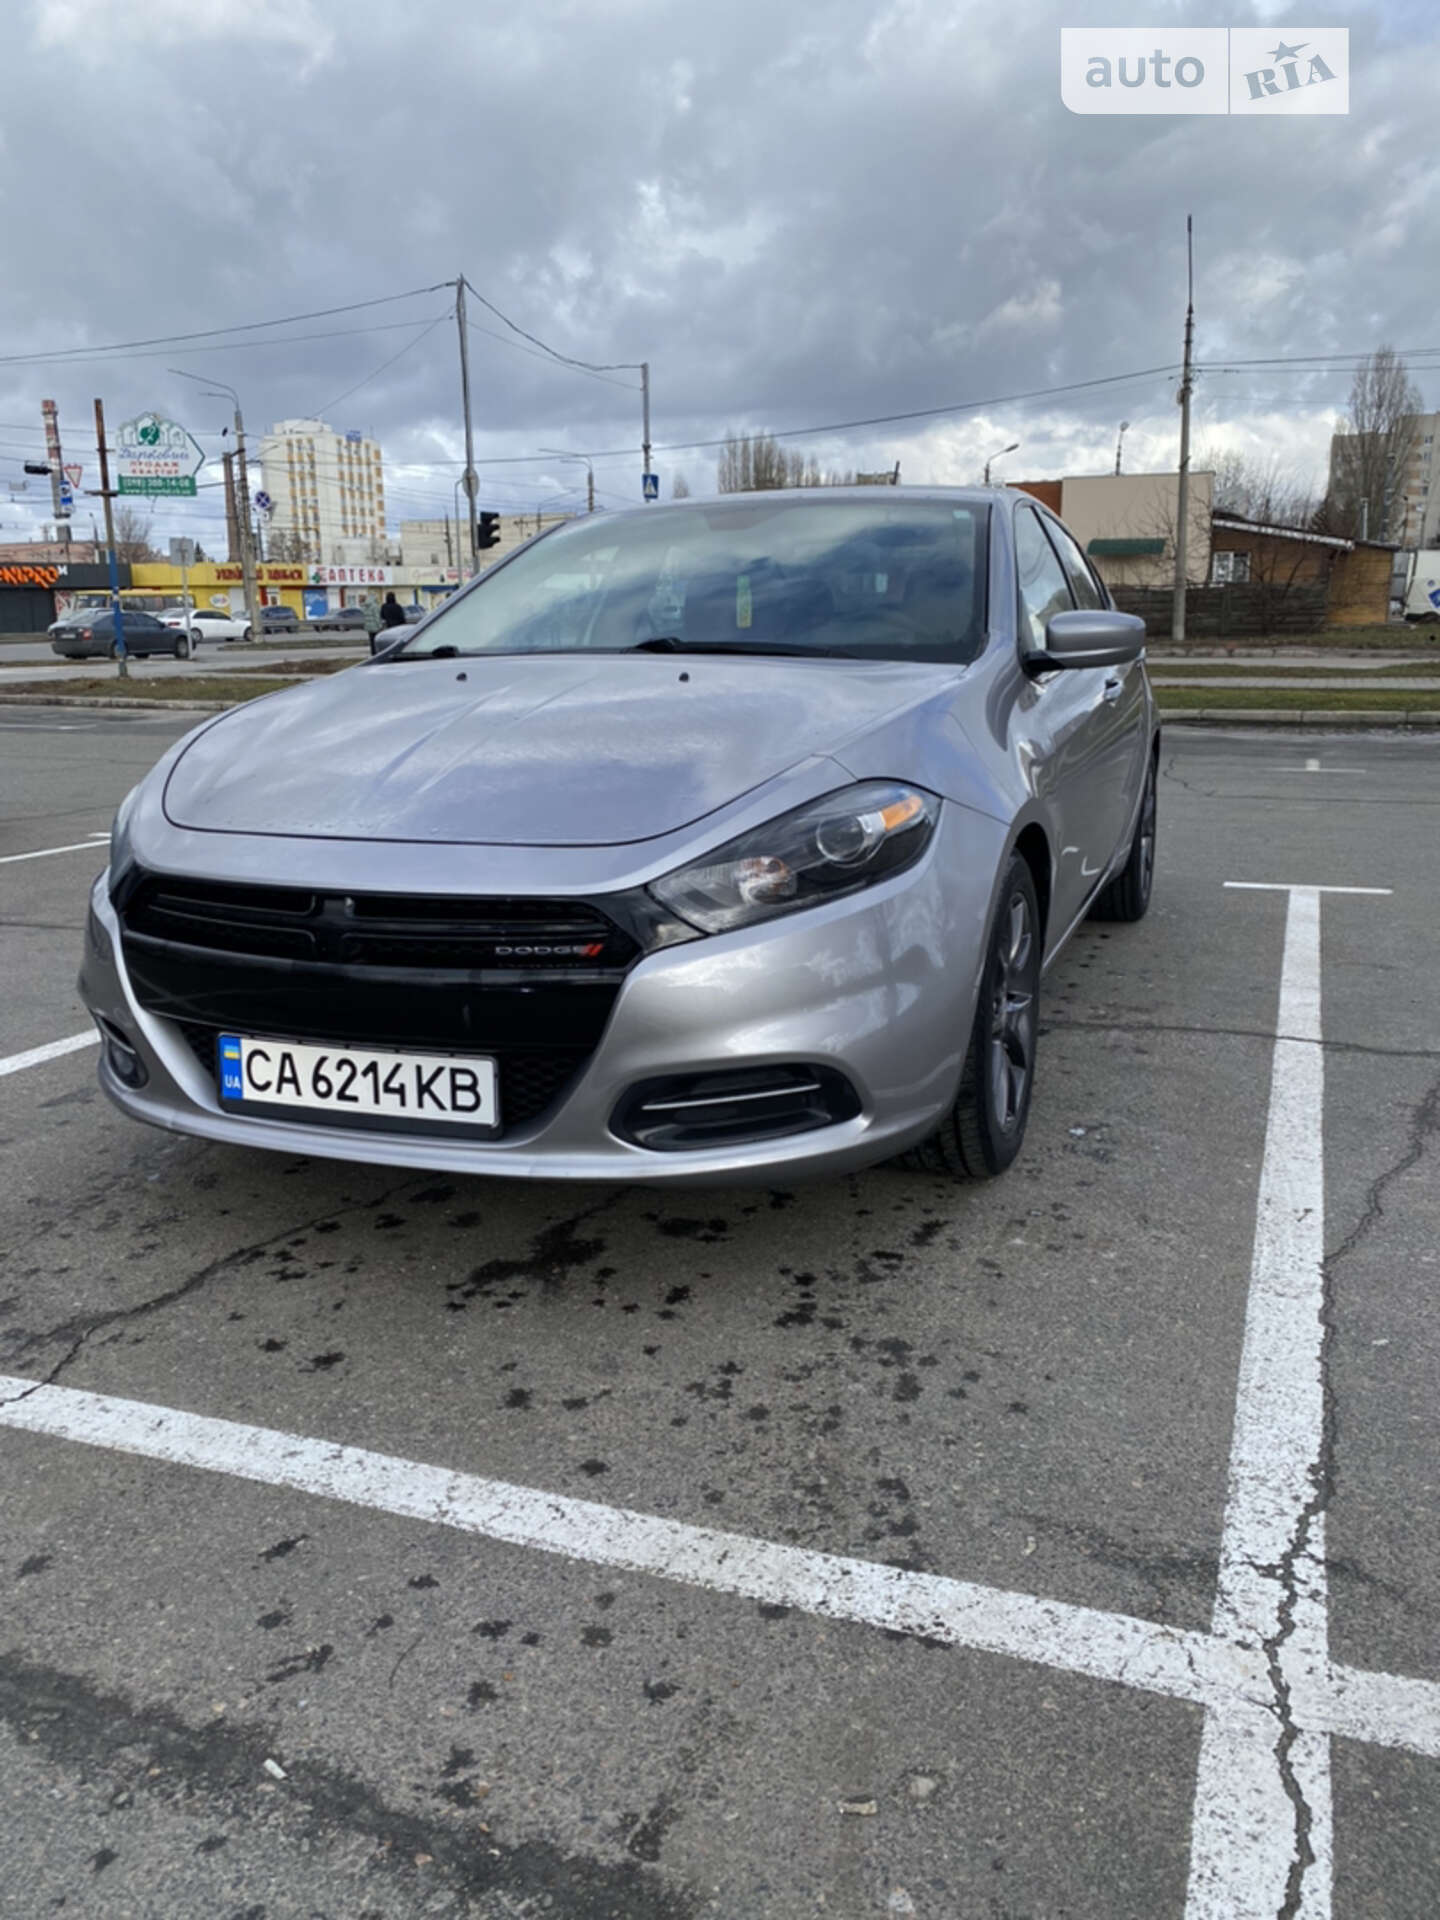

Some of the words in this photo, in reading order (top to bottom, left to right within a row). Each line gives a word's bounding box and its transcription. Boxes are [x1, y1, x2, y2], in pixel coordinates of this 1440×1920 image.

[328, 568, 385, 583] АПТЕКА
[495, 946, 588, 956] DODGE
[224, 1074, 241, 1090] UA
